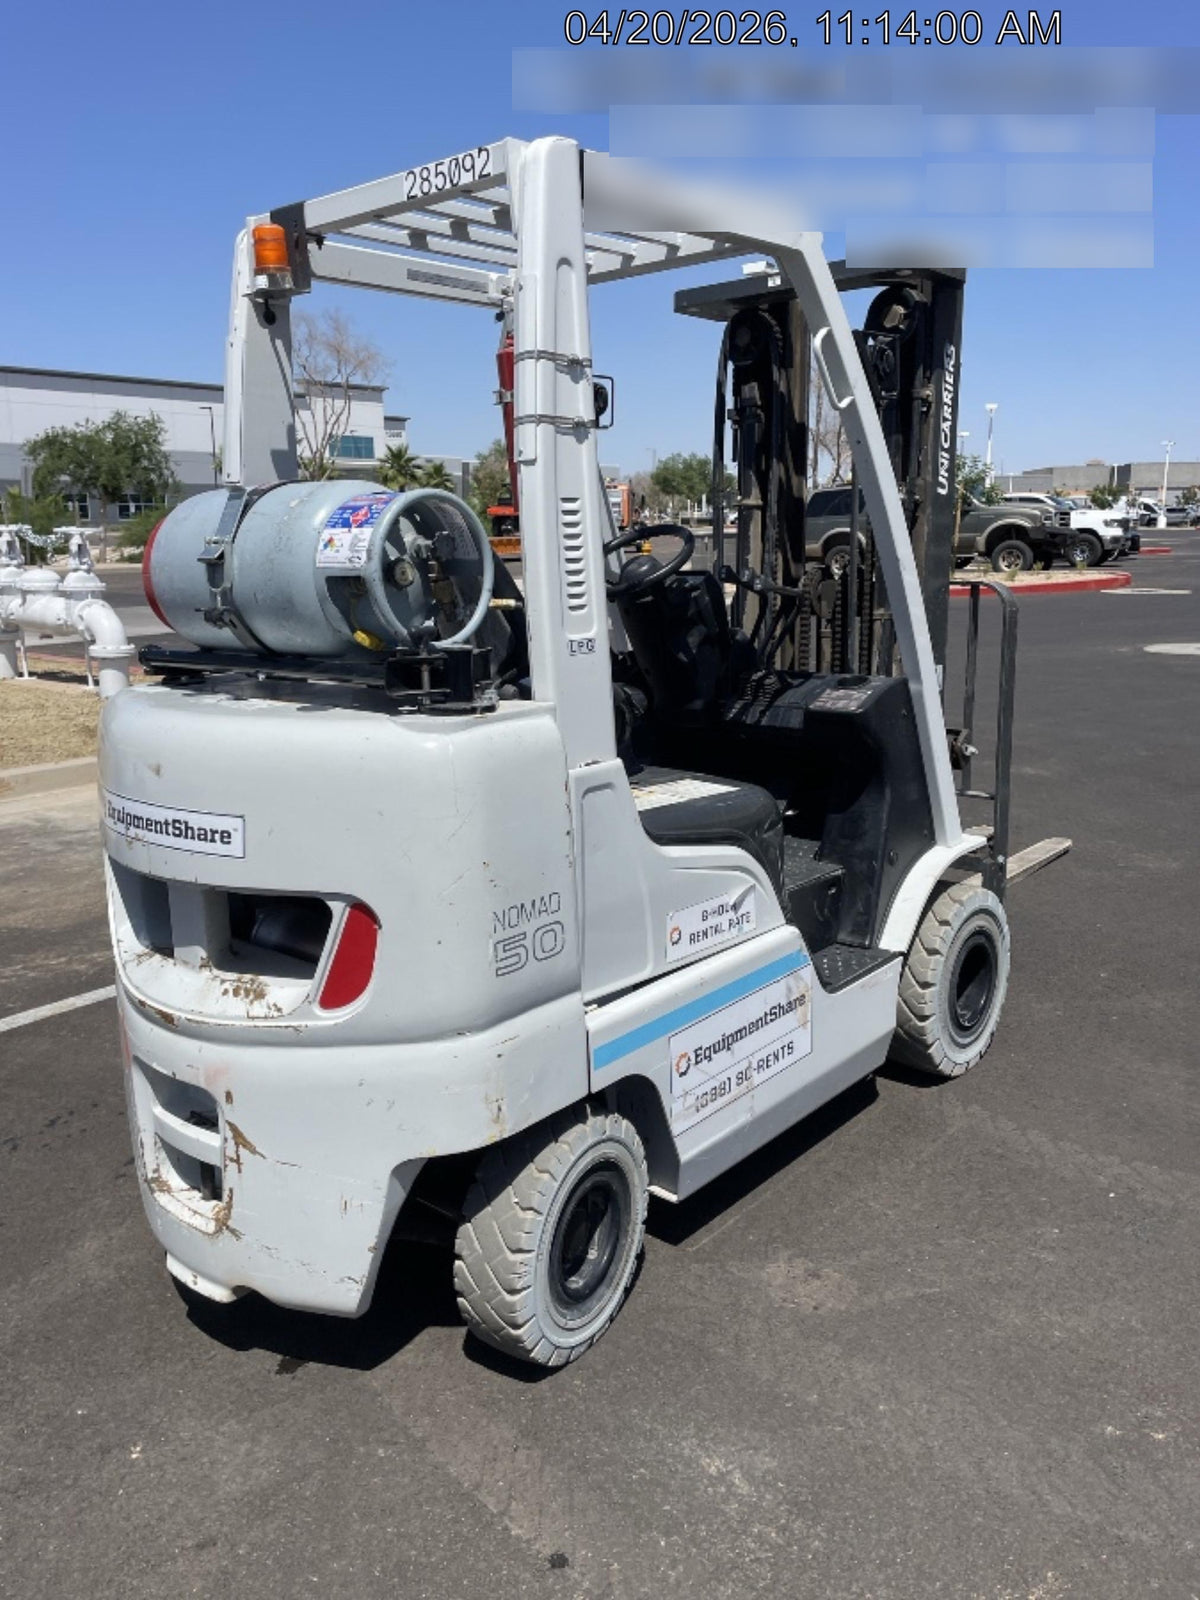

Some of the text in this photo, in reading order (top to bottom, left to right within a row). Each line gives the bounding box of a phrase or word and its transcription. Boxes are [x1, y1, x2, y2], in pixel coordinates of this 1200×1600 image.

[405, 147, 491, 201] 285092
[570, 639, 595, 653] LPG
[493, 892, 561, 934] NOMAD
[689, 911, 751, 945] RENTAL RATE
[494, 920, 565, 977] 50
[693, 993, 806, 1066] EquipmentShare
